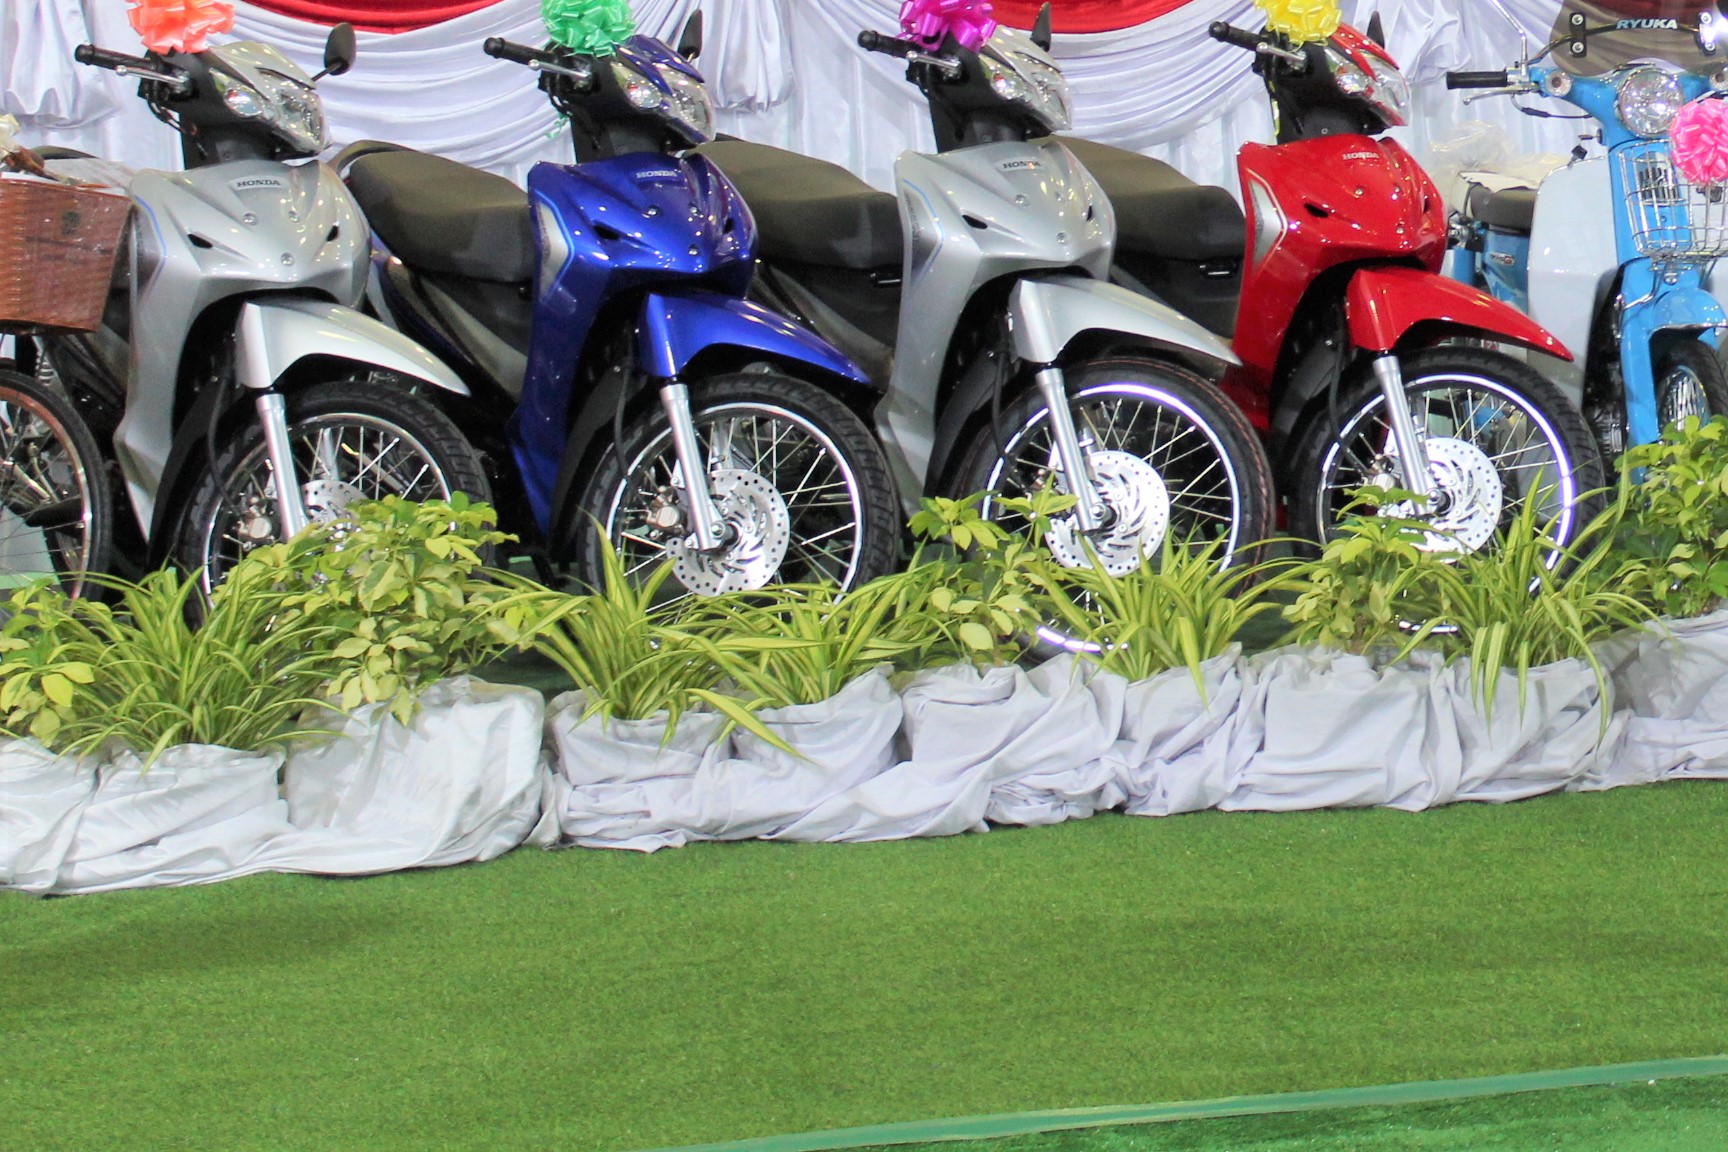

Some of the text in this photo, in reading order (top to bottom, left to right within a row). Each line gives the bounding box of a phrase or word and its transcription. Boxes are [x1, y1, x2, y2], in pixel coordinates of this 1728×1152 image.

[1616, 18, 1678, 29] RYUKA
[1342, 151, 1380, 160] HONDA
[636, 170, 678, 179] HONDA
[236, 179, 281, 188] HONDA
